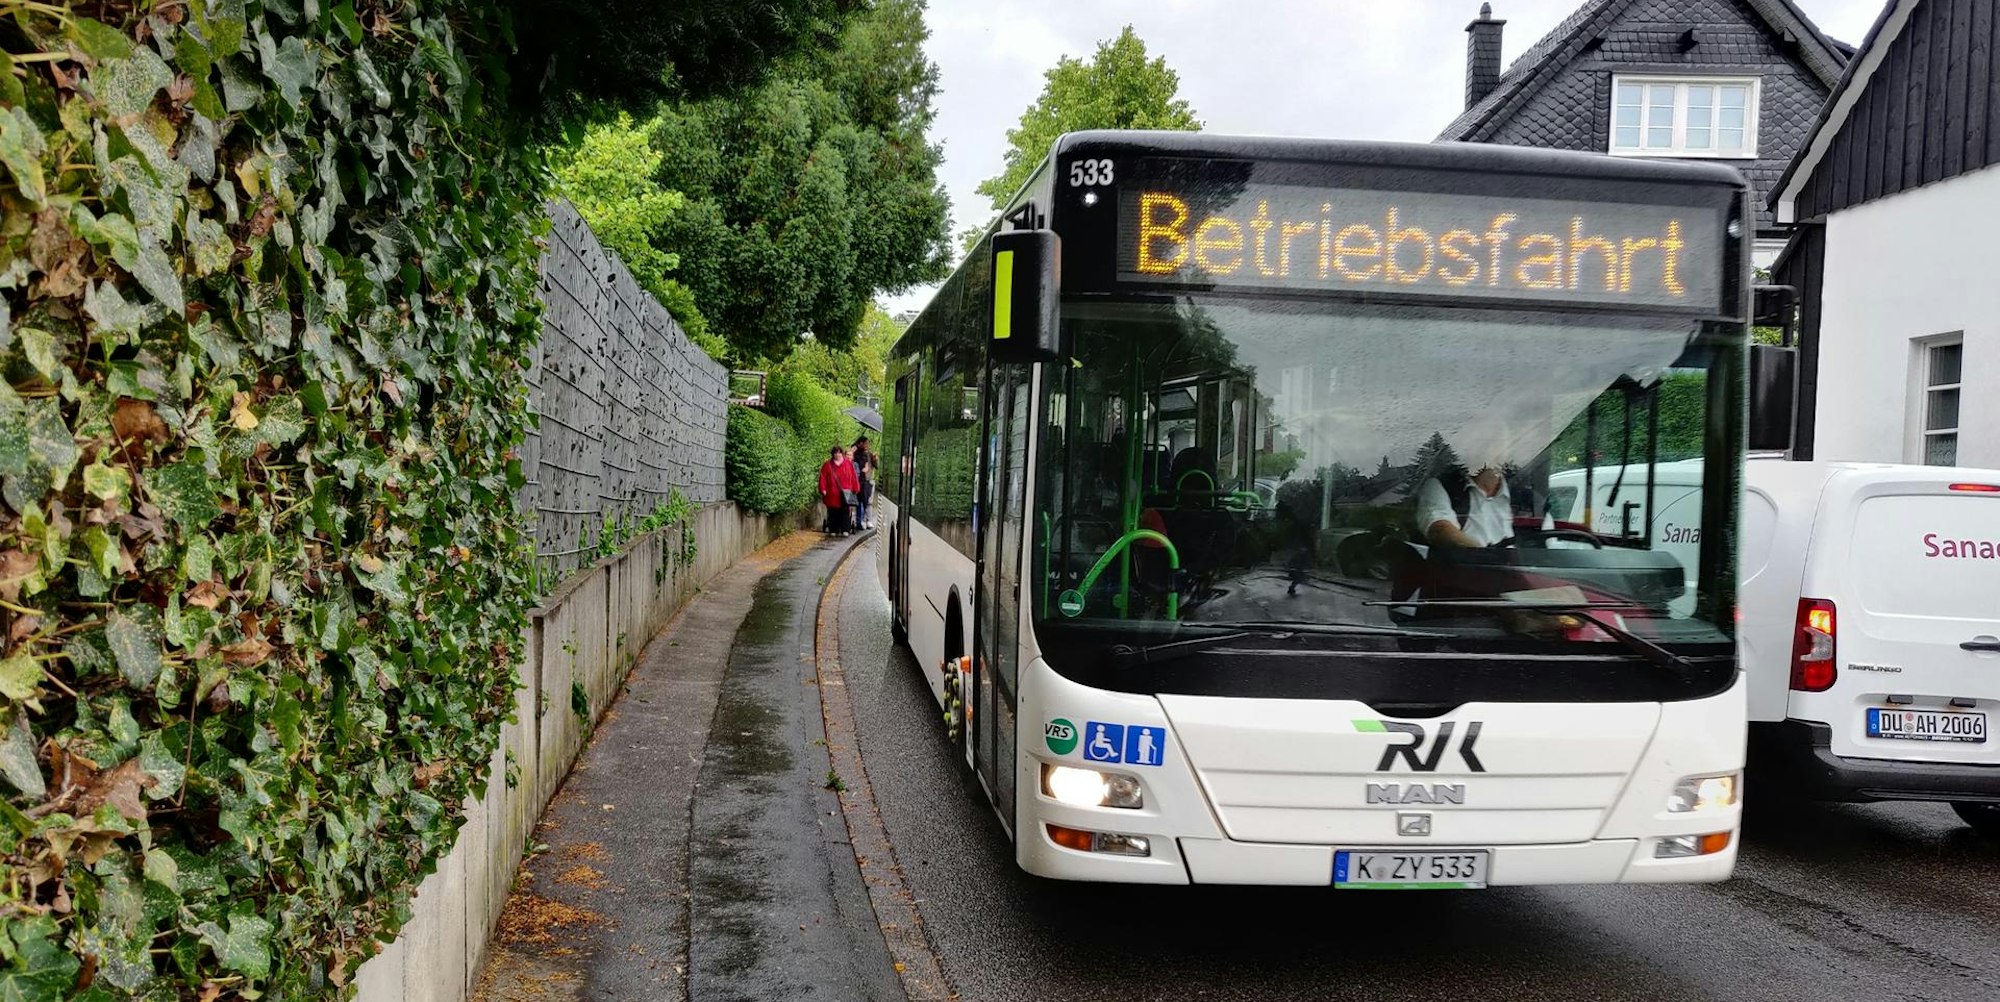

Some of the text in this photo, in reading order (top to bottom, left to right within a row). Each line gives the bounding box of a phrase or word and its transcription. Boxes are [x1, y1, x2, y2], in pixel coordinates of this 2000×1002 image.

[1070, 159, 1114, 187] 533
[1136, 191, 1686, 297] Betriebsfahrt
[1045, 723, 1070, 738] VRS
[1881, 713, 1983, 735] DU AH 2006
[1366, 782, 1465, 805] MAN
[1358, 856, 1476, 879] K ZY 533
